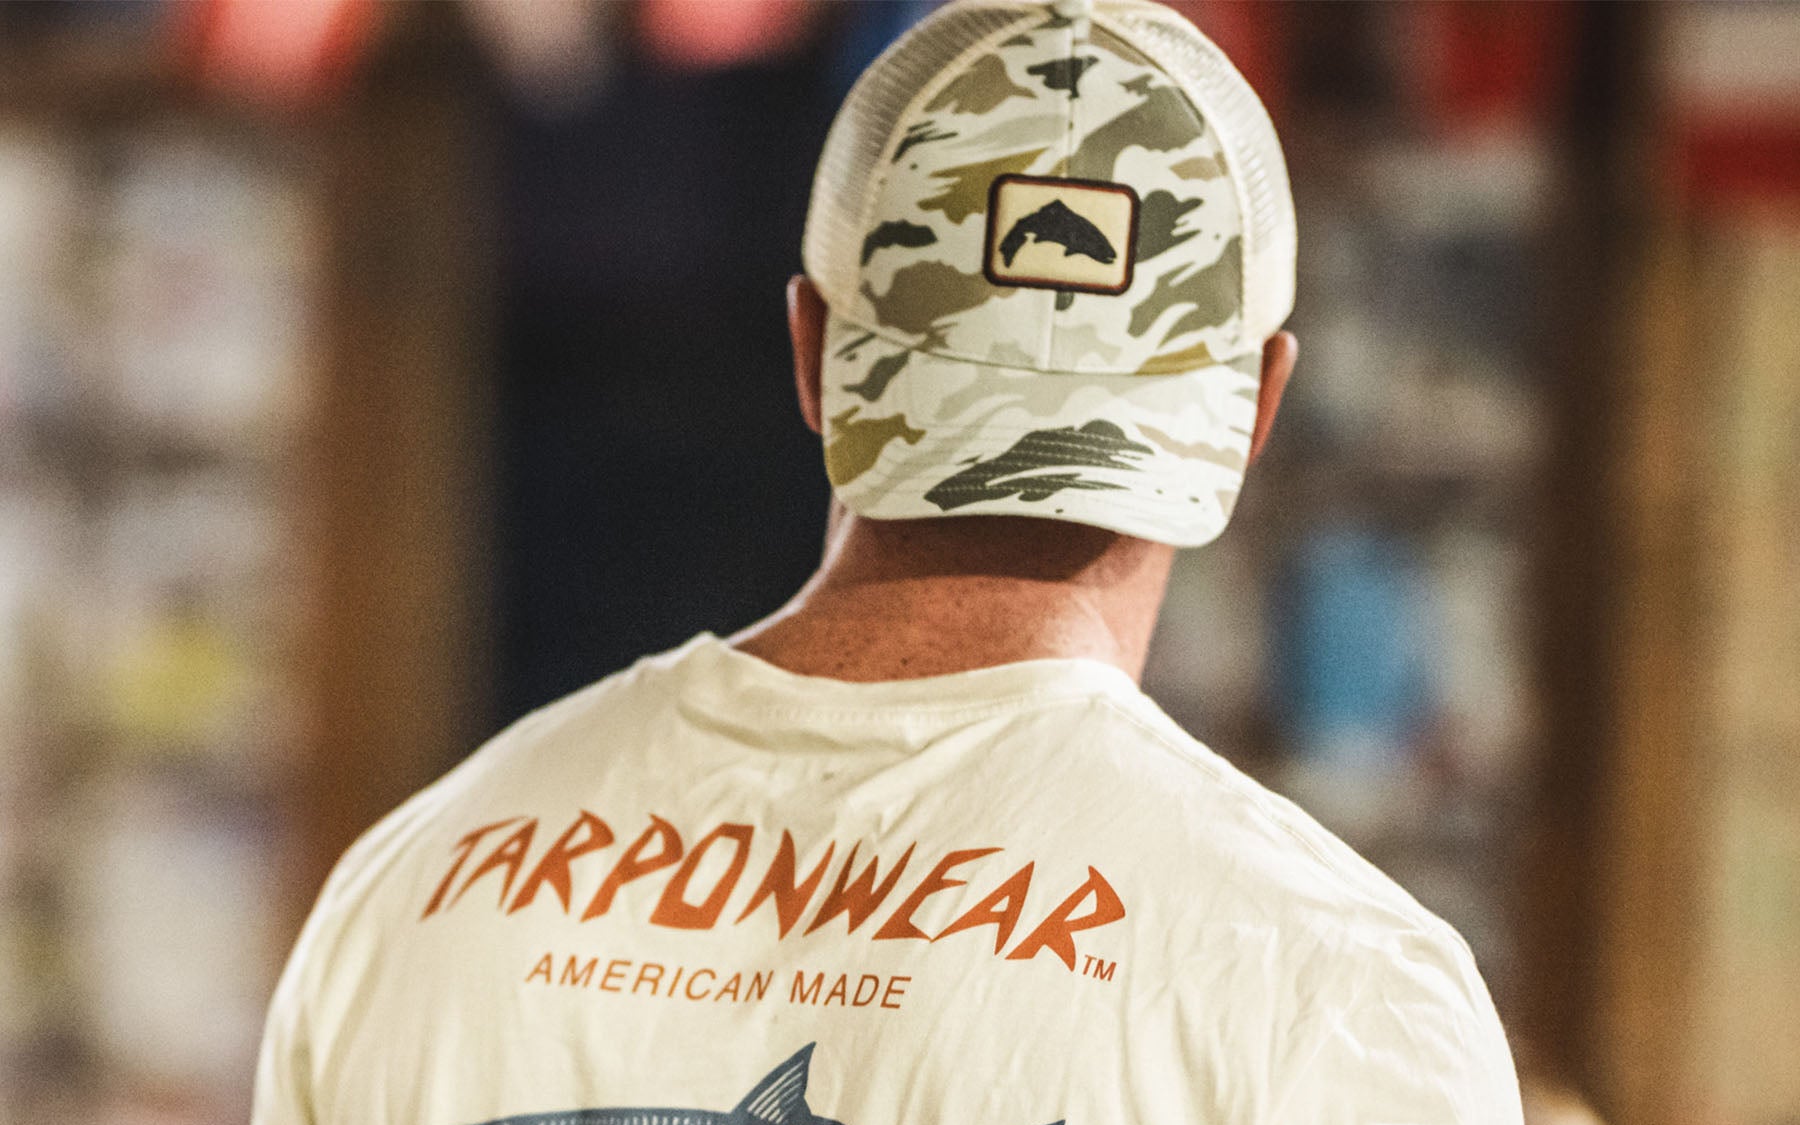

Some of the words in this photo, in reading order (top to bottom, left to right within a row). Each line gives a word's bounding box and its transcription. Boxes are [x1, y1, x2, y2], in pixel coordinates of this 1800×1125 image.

[421, 810, 1126, 972] TARPONWEAR
[526, 952, 776, 1004] AMERICAN
[791, 971, 912, 1010] MADE
